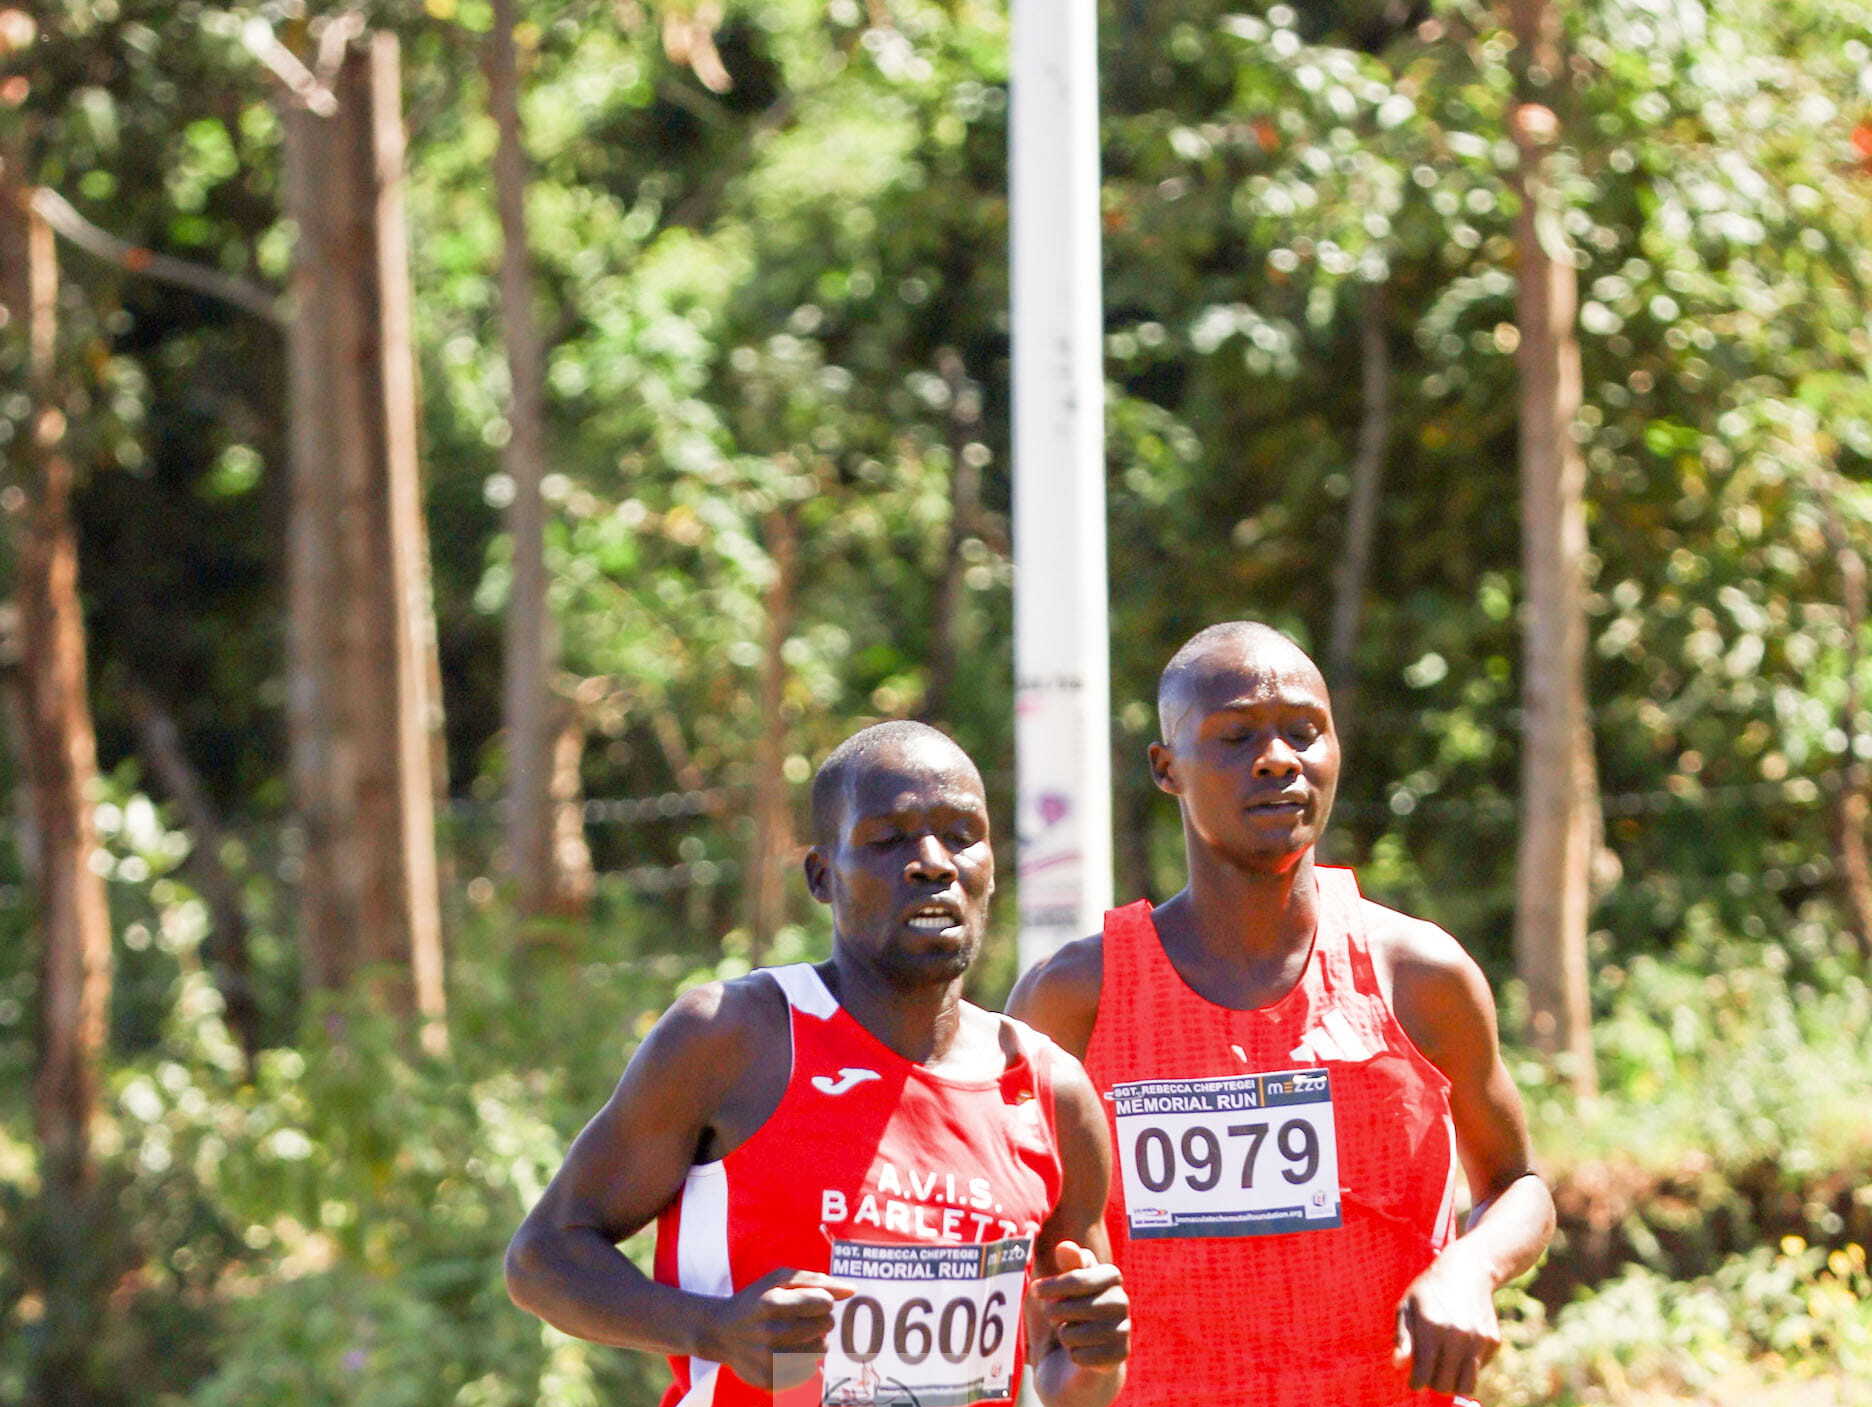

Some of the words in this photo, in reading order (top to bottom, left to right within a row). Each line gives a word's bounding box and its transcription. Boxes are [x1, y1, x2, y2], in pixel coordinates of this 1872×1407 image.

[1115, 1096, 1213, 1115] MEMORIAL
[1216, 1092, 1257, 1110] RUN
[1142, 1084, 1192, 1097] REBECCA
[1193, 1079, 1256, 1093] CHEPTEGEI
[1134, 1118, 1320, 1193] 0979
[877, 1162, 1003, 1213] A.V.I.S.
[821, 1189, 1040, 1244] BARLETT
[833, 1259, 935, 1278] MEMORIAL
[938, 1261, 978, 1278] RUN
[835, 1245, 860, 1257] SGT.
[863, 1246, 918, 1259] REBECCA
[920, 1248, 979, 1260] CHEPTEGEI
[840, 1290, 1007, 1365] 0606
